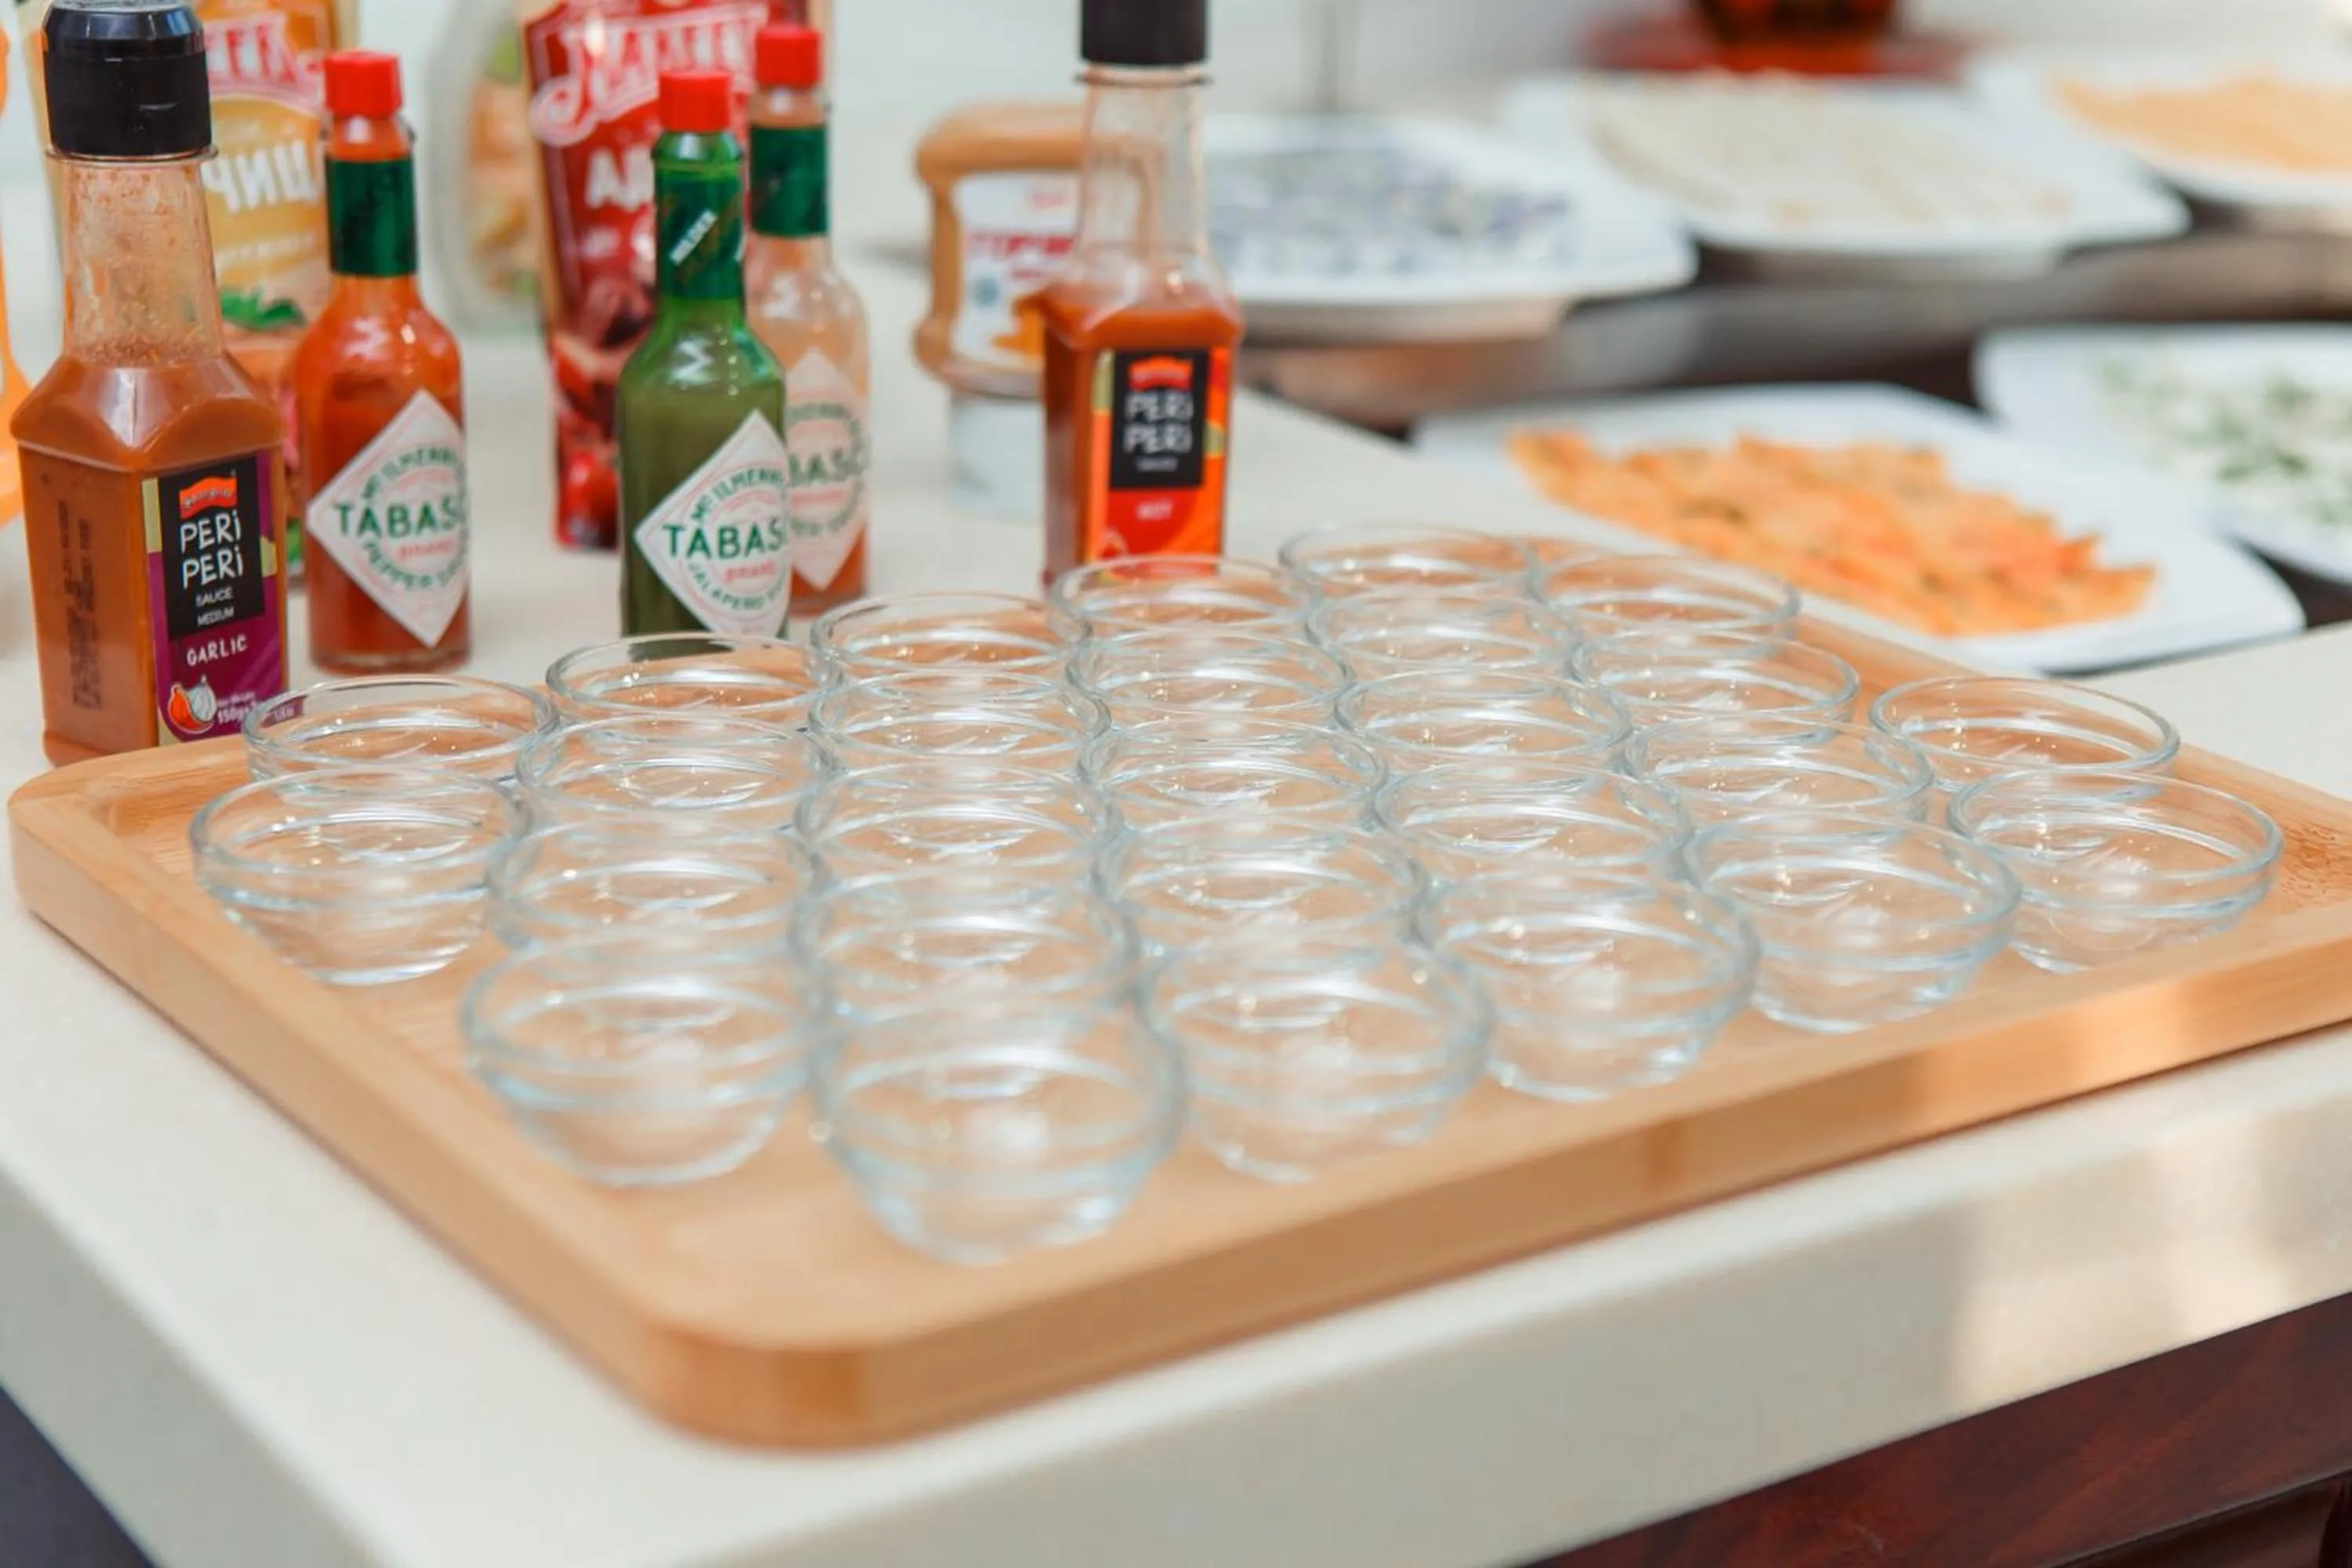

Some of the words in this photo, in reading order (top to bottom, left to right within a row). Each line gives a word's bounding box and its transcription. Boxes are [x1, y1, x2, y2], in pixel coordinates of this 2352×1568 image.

[330, 495, 464, 538] TABAS
[662, 517, 786, 559] TABAS
[196, 586, 233, 606] SAUCE
[198, 607, 234, 626] MEDIUM
[187, 633, 248, 666] GARLIC
